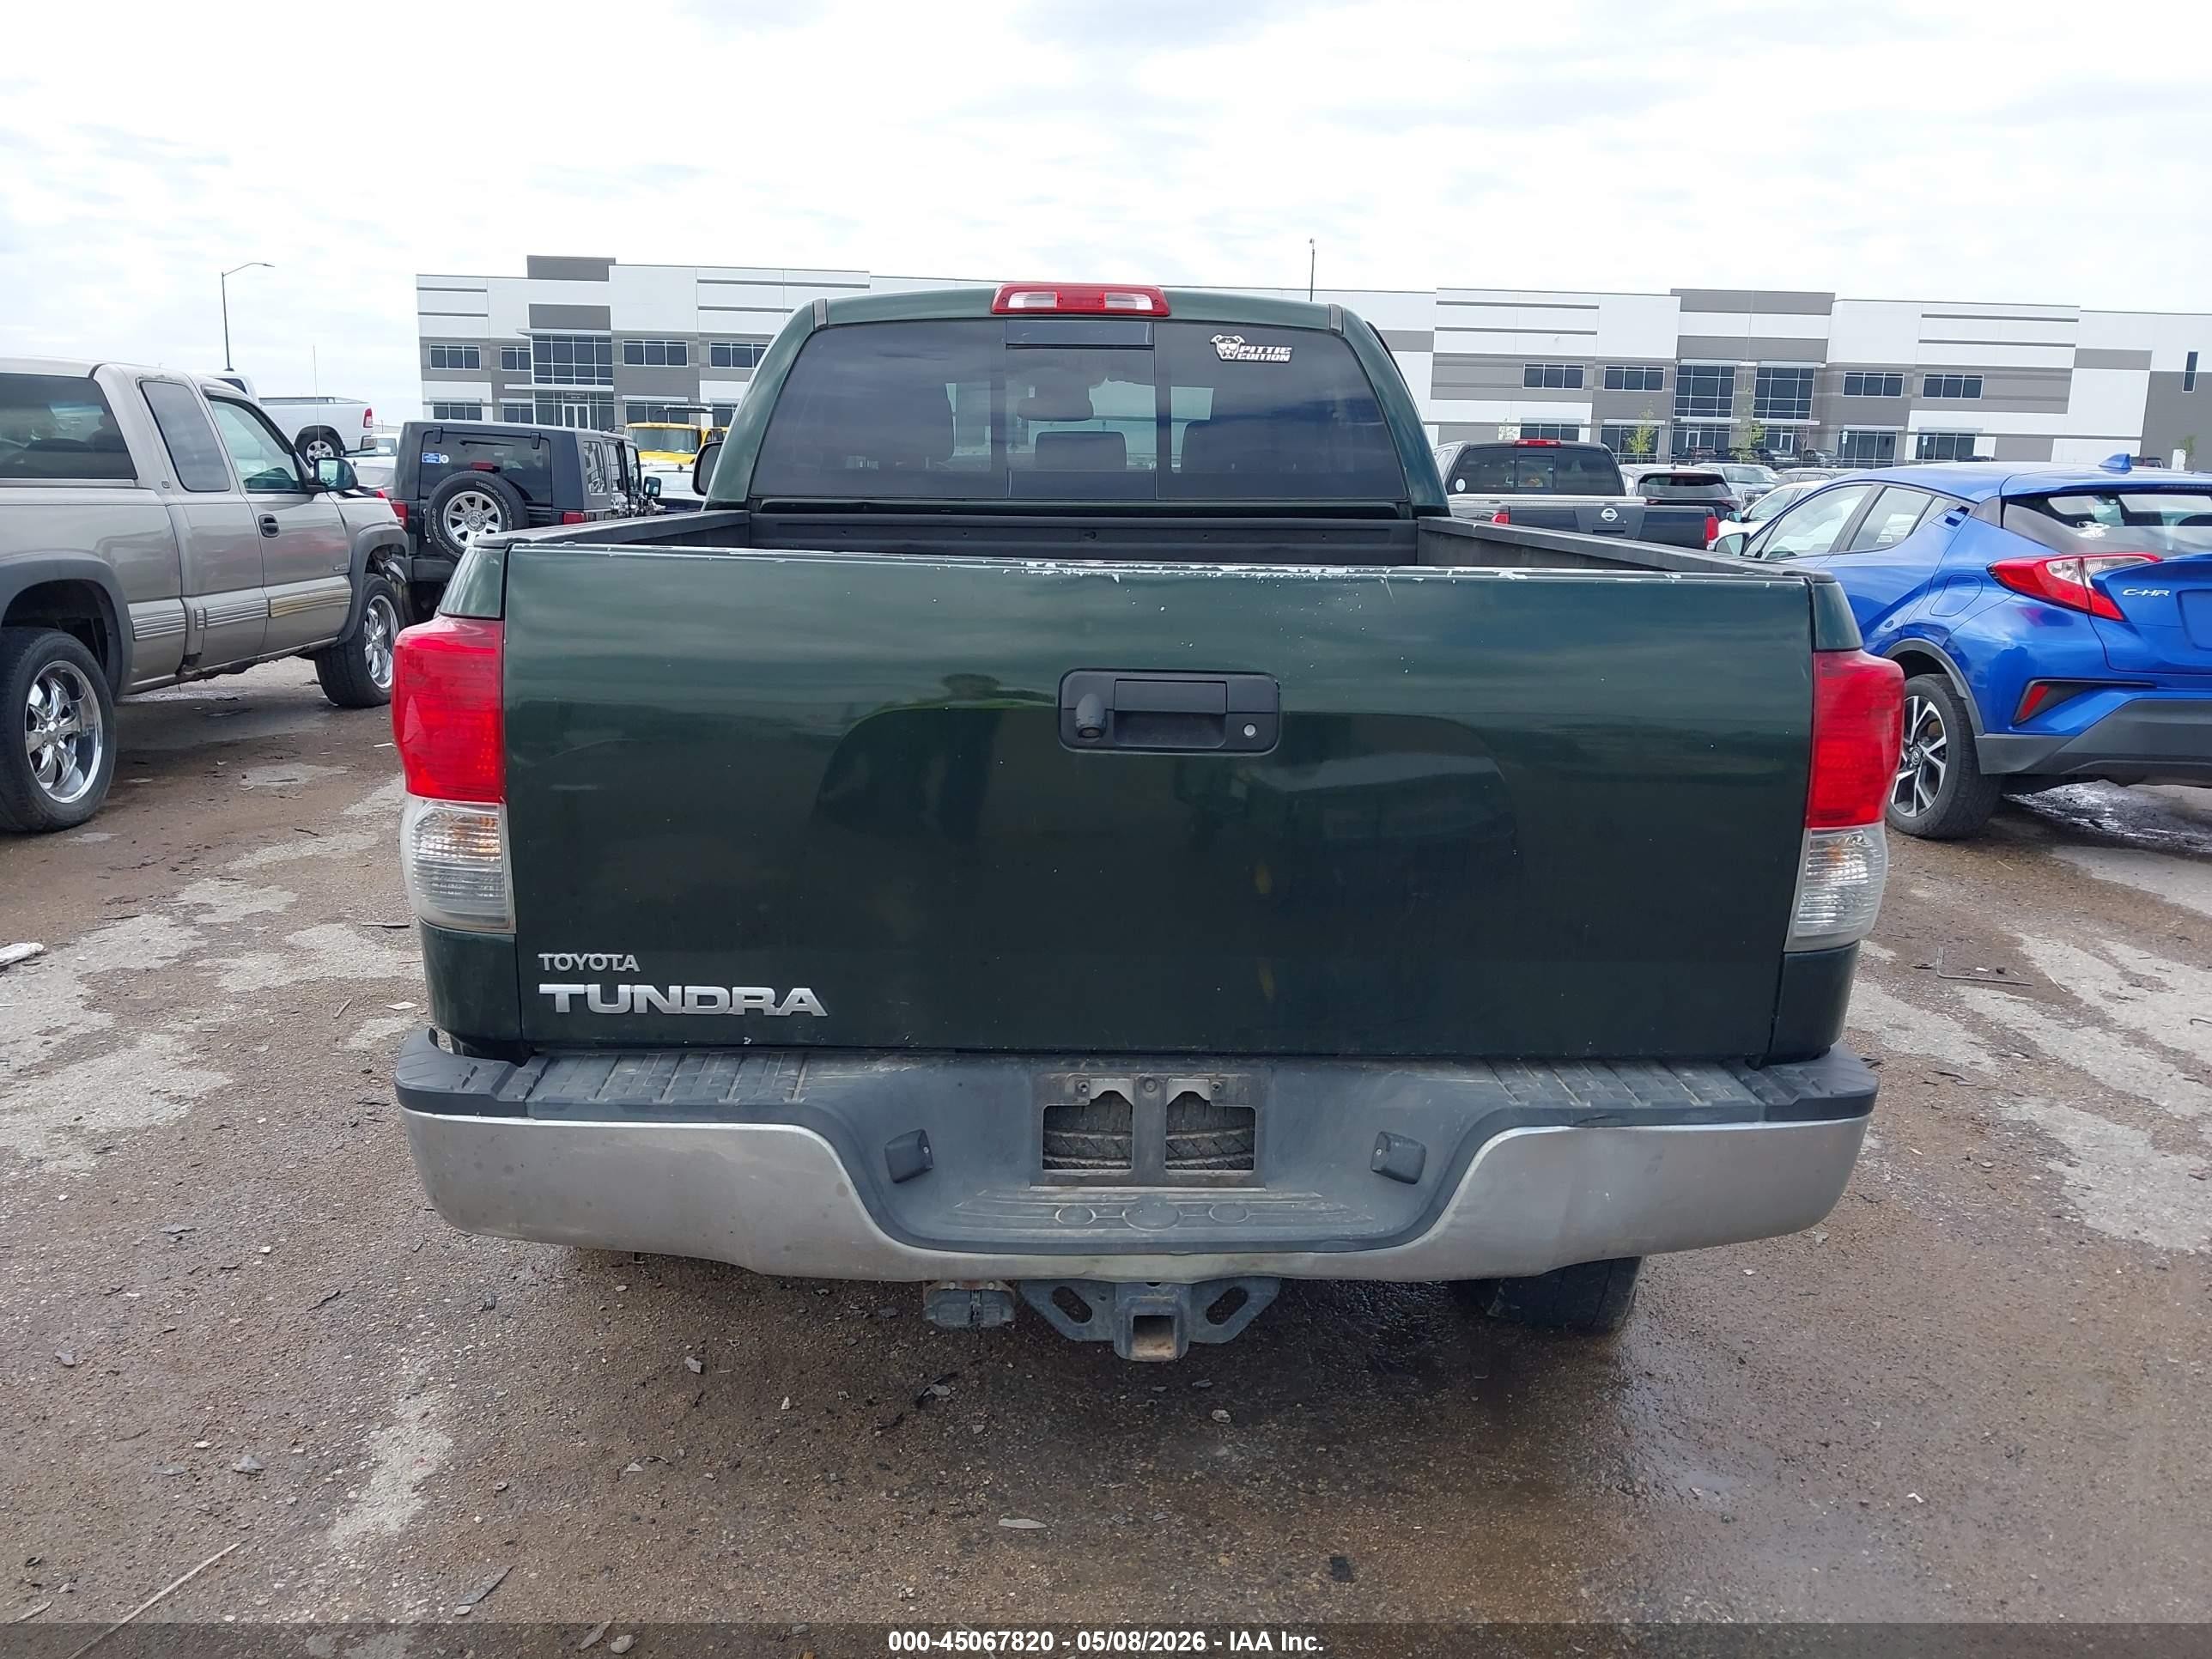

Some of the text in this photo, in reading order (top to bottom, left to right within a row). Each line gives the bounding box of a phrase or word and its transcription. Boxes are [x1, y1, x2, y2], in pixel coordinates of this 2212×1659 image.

[1239, 345, 1291, 354] PITTIE
[1237, 353, 1291, 362] EDITION
[2122, 588, 2171, 597] C-HR
[538, 953, 641, 972] TOYOTA
[539, 983, 828, 1017] TUNDRA
